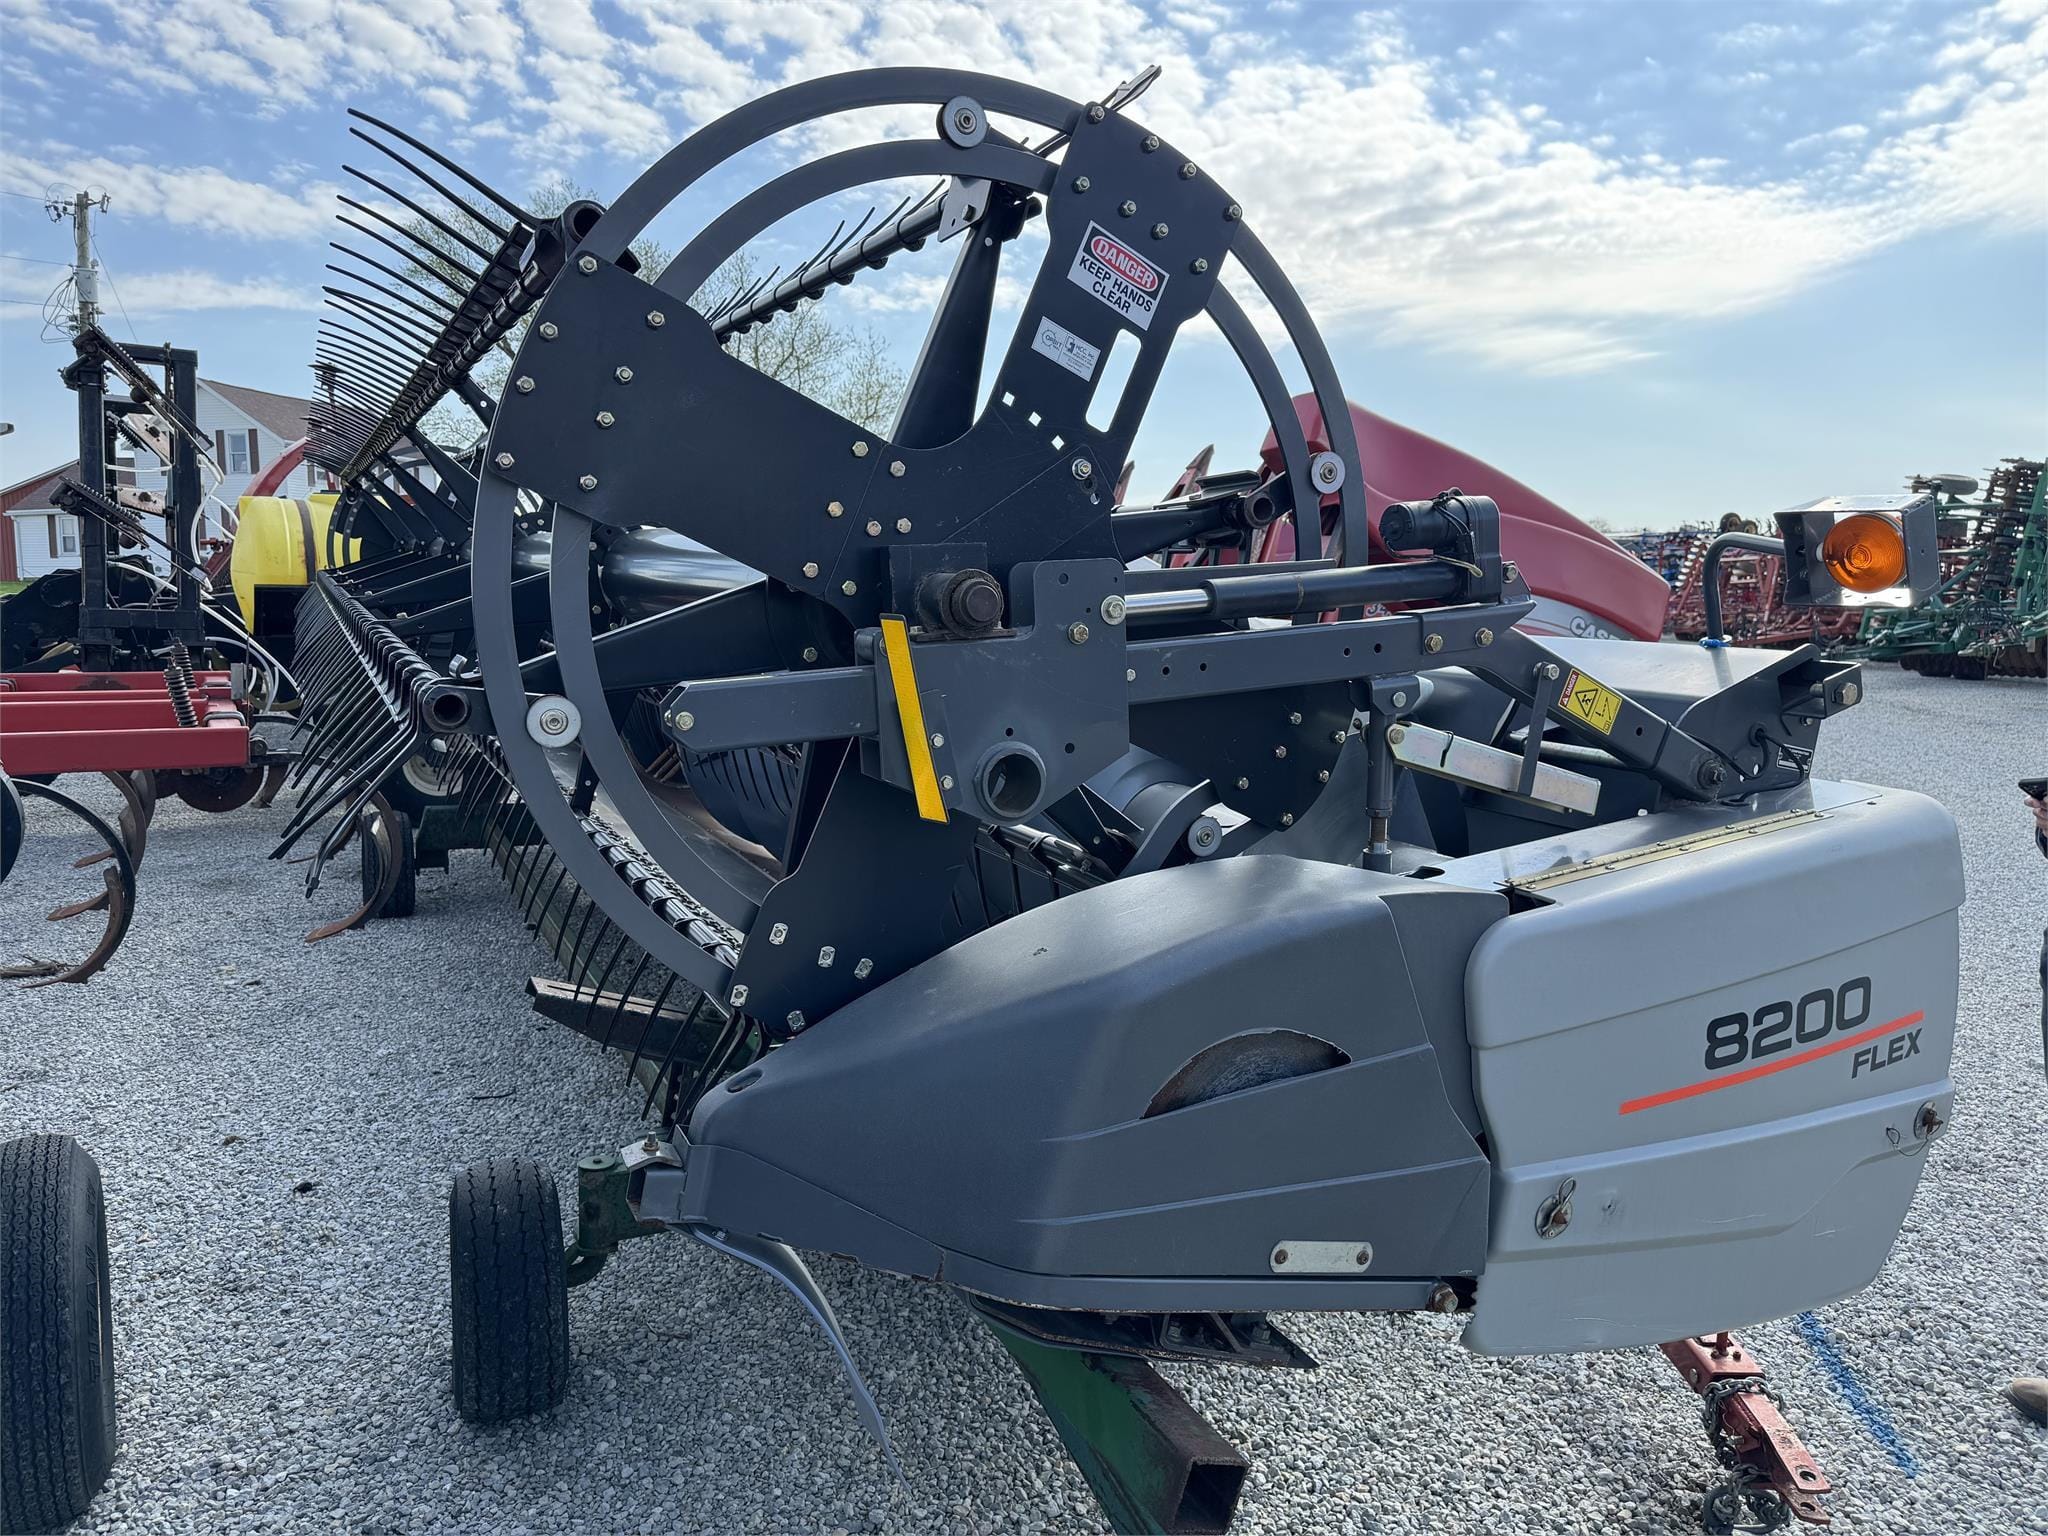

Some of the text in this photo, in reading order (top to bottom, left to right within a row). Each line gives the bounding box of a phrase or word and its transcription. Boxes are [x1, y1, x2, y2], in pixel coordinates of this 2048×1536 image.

[1079, 255, 1153, 312] KEEP HANDS
[1094, 239, 1154, 289] DANGER
[1092, 281, 1131, 313] CLEAR
[1570, 616, 1620, 640] CAS
[1565, 673, 1577, 696] DANGER
[1705, 976, 1871, 1070] 8200
[1852, 1028, 1922, 1079] FLEX
[85, 1244, 101, 1385] TITAN
